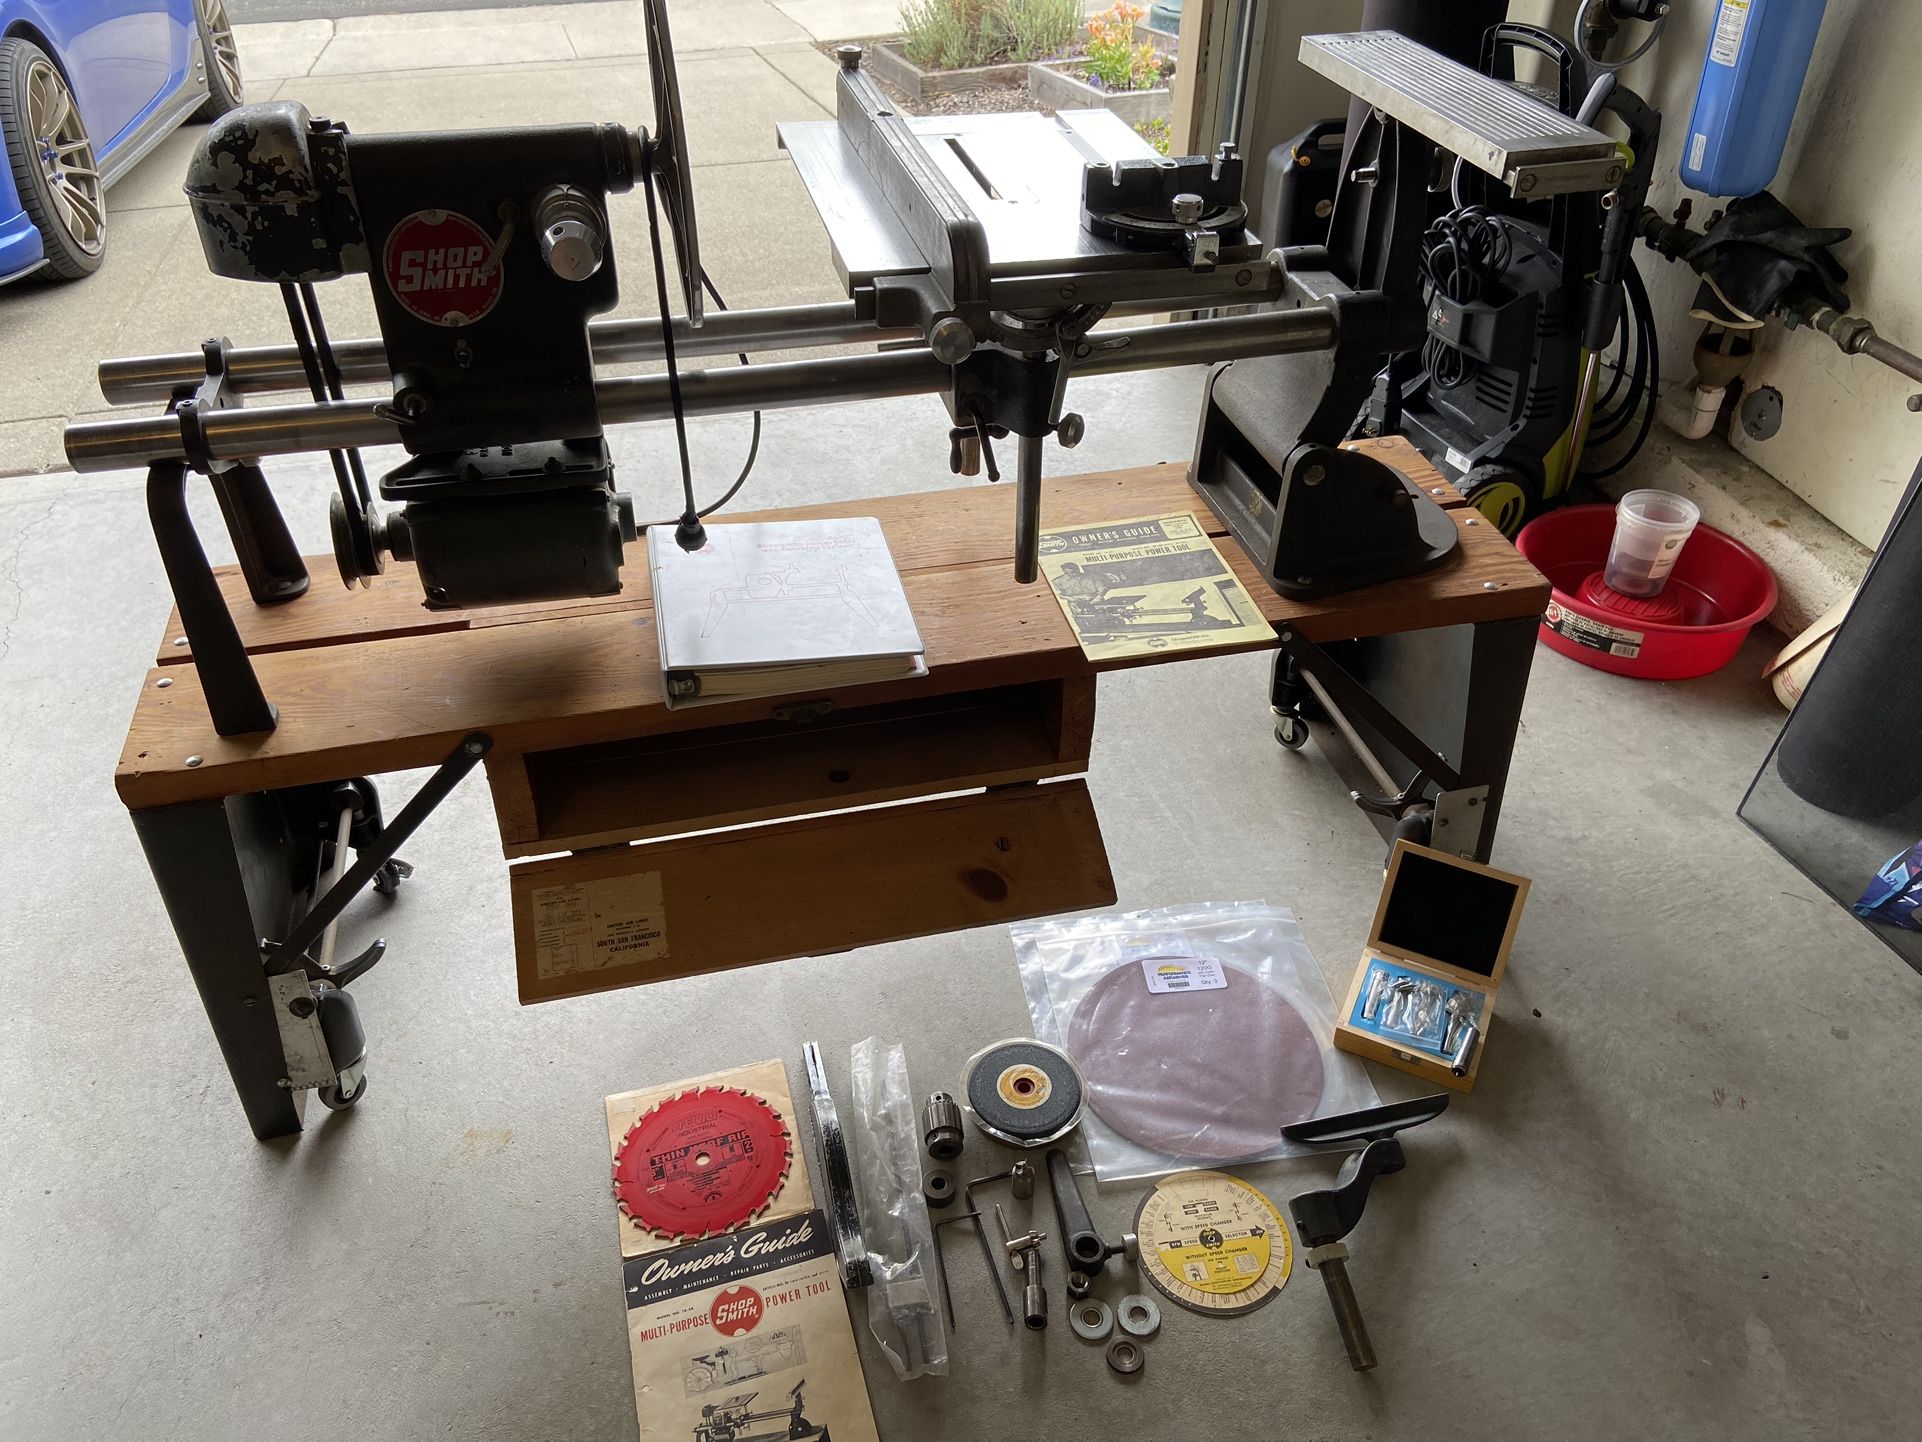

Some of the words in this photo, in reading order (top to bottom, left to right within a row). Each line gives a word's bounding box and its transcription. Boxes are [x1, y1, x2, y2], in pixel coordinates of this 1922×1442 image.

[398, 246, 484, 285] SHOP
[1072, 530, 1119, 544] OWNER'S
[1123, 525, 1157, 537] GUIDE
[1145, 546, 1172, 556] POWER
[1173, 543, 1191, 552] TOOL
[606, 921, 624, 929] UNITED
[596, 937, 615, 948] SOUTH
[617, 936, 629, 944] SAN
[631, 930, 661, 942] FRANCISCO
[609, 941, 650, 953] CALIFORNIA
[677, 1122, 718, 1138] INDUSTRIAL
[654, 1148, 686, 1165] THIN
[727, 1131, 750, 1143] RIP
[1210, 1219, 1232, 1227] CHANGER
[1224, 1231, 1248, 1239] SELECTOR
[641, 1246, 737, 1285] Owner's
[740, 1219, 814, 1257] Guide
[644, 1288, 673, 1300] ASSEMBLY
[683, 1275, 720, 1290] MAINTENANCE
[730, 1267, 749, 1277] REPAIR
[753, 1263, 769, 1272] PARTS
[780, 1249, 815, 1263] ACCESSORIES
[765, 1293, 802, 1308] POWER
[805, 1279, 832, 1298] TOOL
[716, 1305, 757, 1324] SMITH
[640, 1313, 710, 1342] MULTI-PURPOSE
